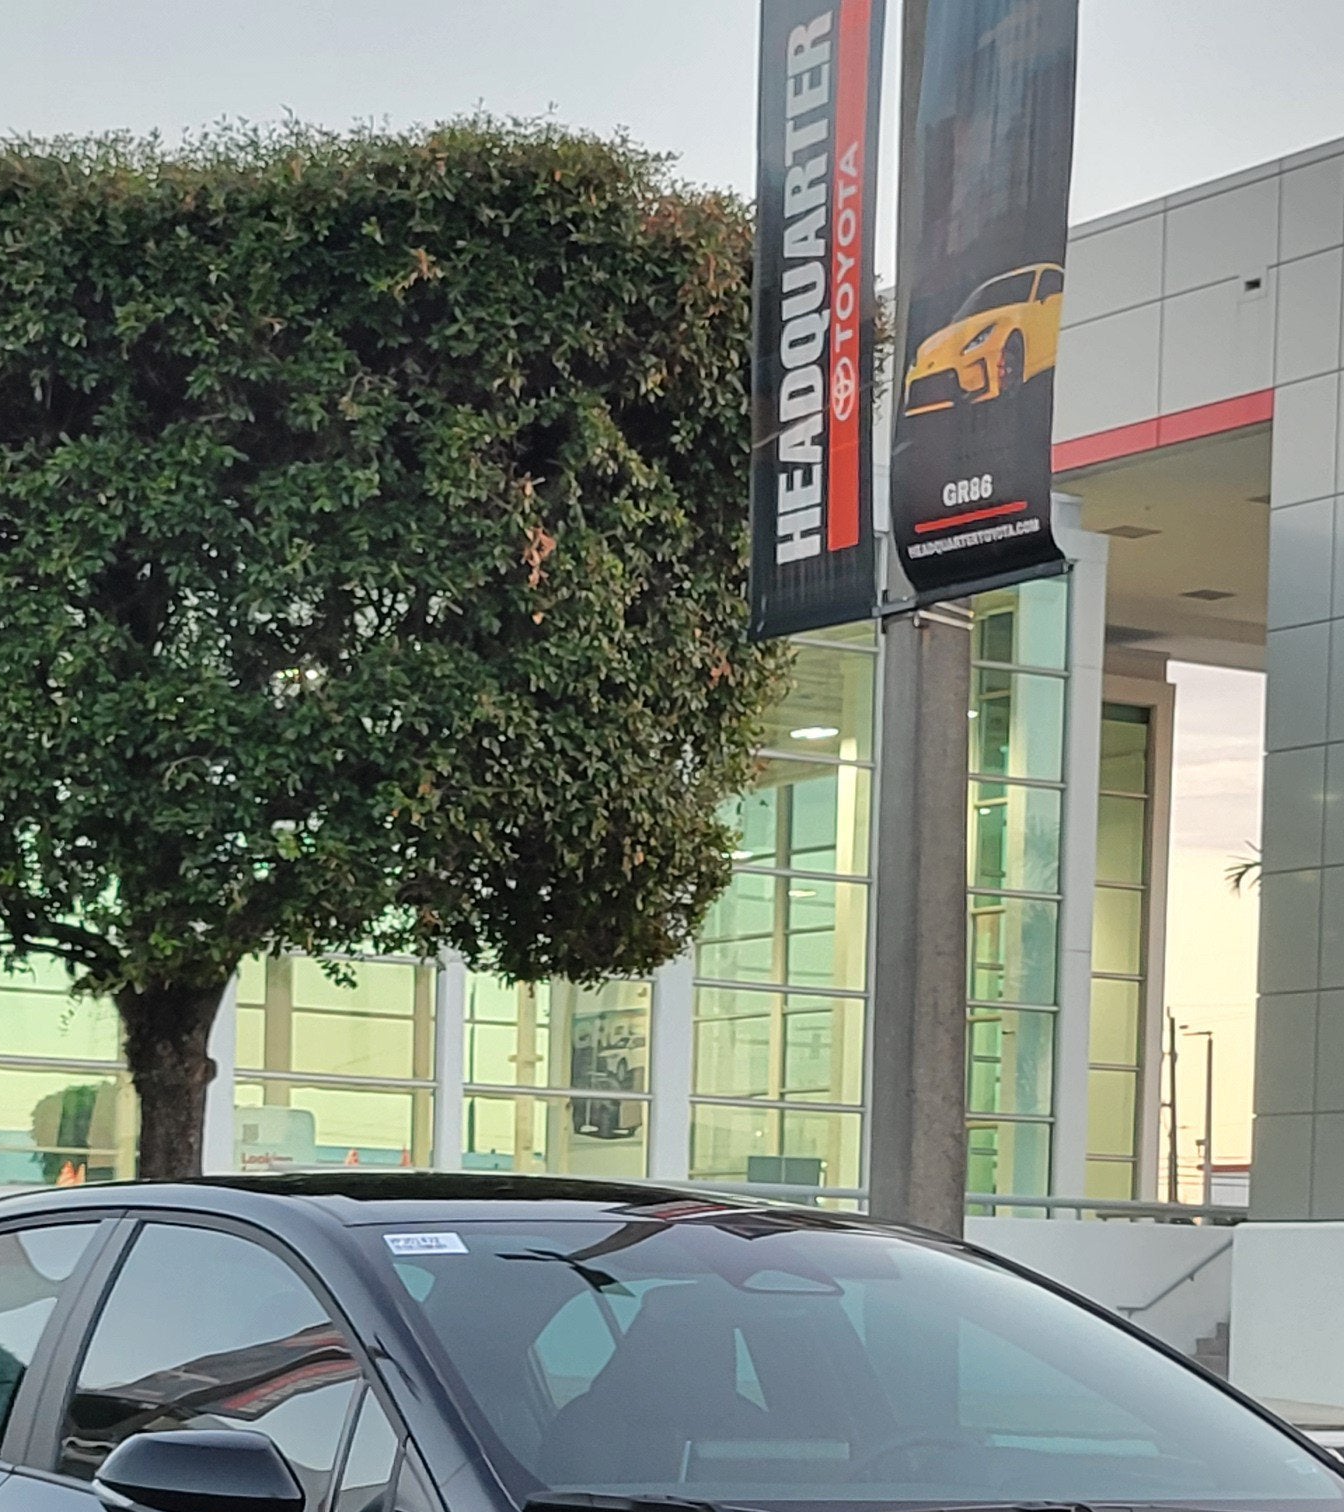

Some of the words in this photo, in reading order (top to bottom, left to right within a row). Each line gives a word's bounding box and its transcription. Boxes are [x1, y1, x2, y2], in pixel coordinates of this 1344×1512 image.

[777, 10, 833, 565] HEADQUARTER
[835, 141, 858, 352] TOYOTA
[943, 474, 993, 507] GR86
